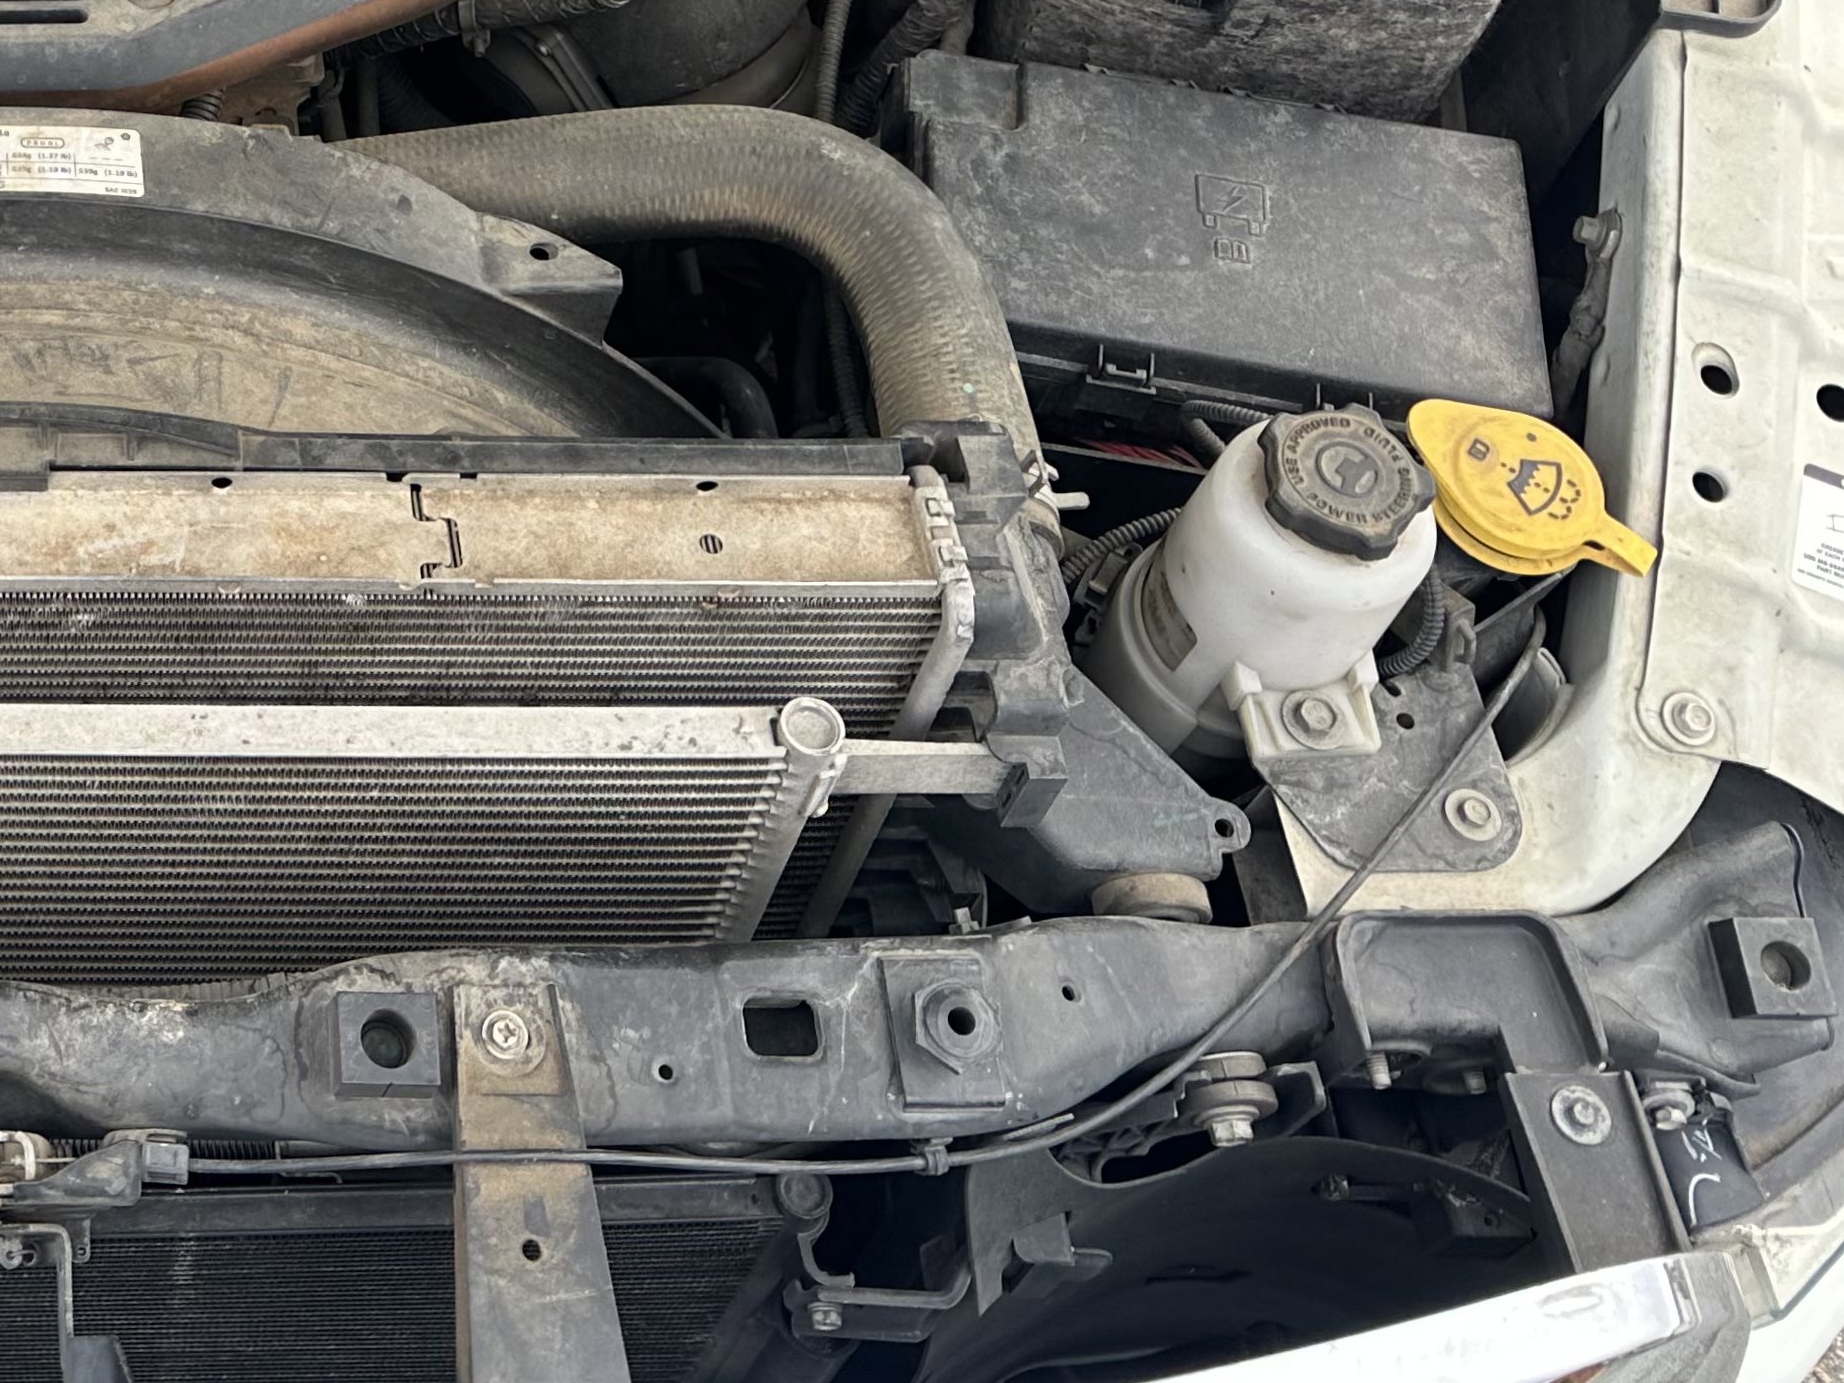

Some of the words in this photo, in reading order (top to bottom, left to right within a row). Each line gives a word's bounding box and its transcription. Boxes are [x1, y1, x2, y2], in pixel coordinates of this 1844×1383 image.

[1286, 416, 1351, 454] APPROVED
[1363, 427, 1405, 462] FLUID
[1286, 457, 1305, 485] USE
[1306, 492, 1367, 524] POWER
[1372, 466, 1411, 524] STEERING
